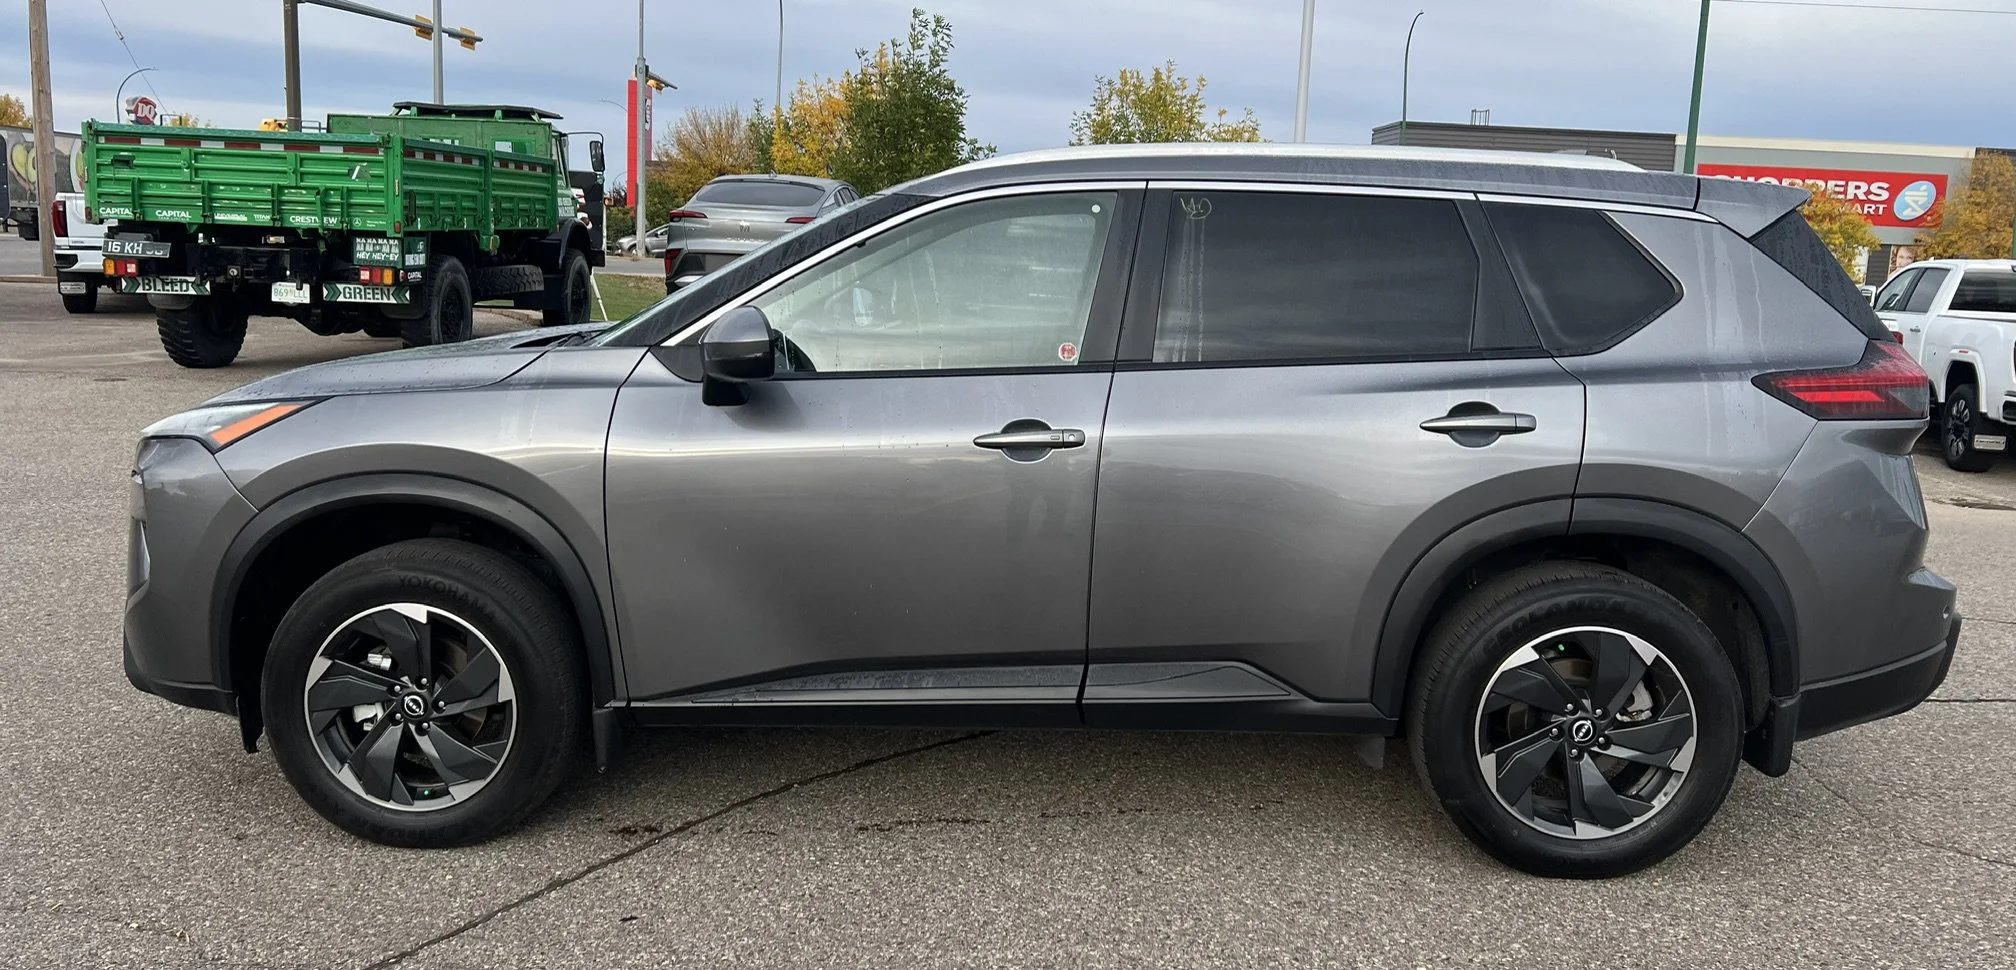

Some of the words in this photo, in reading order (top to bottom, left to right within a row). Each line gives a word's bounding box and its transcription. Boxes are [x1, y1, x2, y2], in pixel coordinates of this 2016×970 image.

[137, 102, 155, 121] DQ
[155, 209, 192, 218] CAPITAL
[289, 215, 338, 224] CRESTEW
[107, 241, 121, 253] 16
[124, 242, 143, 254] KH
[356, 251, 371, 260] HEY
[142, 277, 190, 293] BLEED
[273, 287, 289, 298] 869
[342, 286, 391, 301] GREEN
